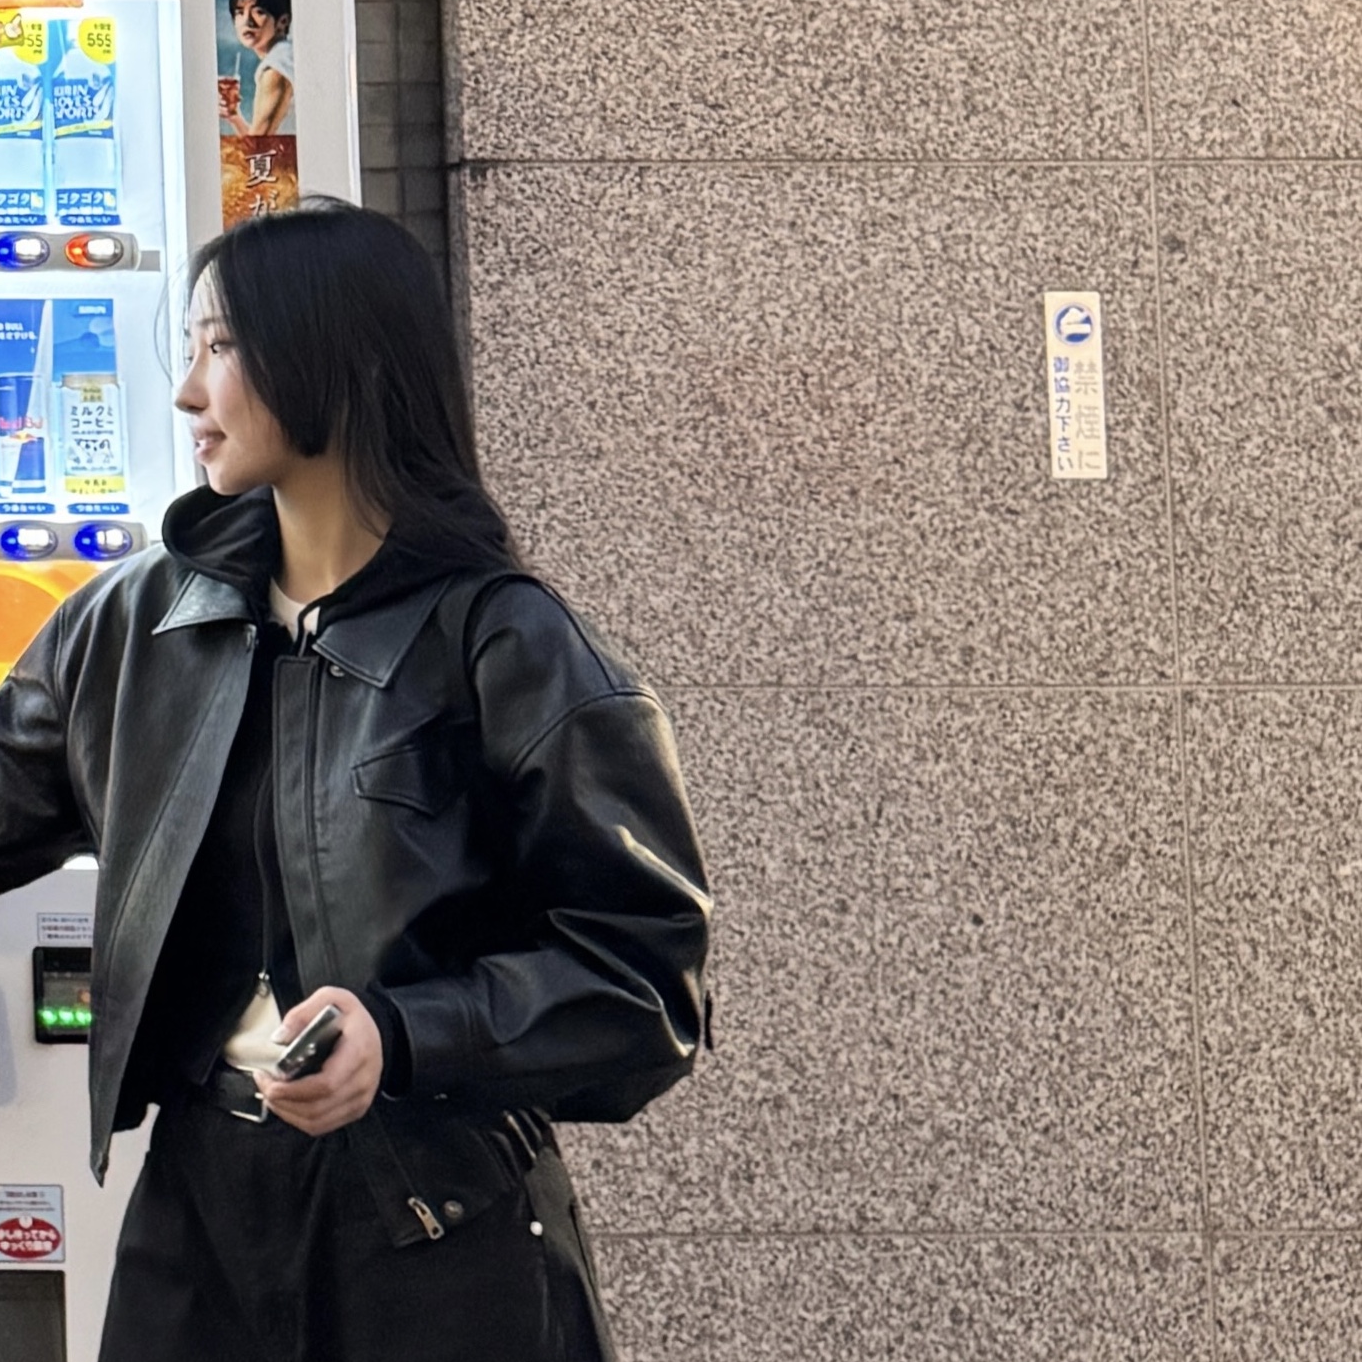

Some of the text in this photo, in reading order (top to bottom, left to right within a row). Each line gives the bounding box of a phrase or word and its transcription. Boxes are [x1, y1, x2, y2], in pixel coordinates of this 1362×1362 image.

[5, 322, 24, 331] BULL
[1074, 359, 1102, 471] 禁煙に
